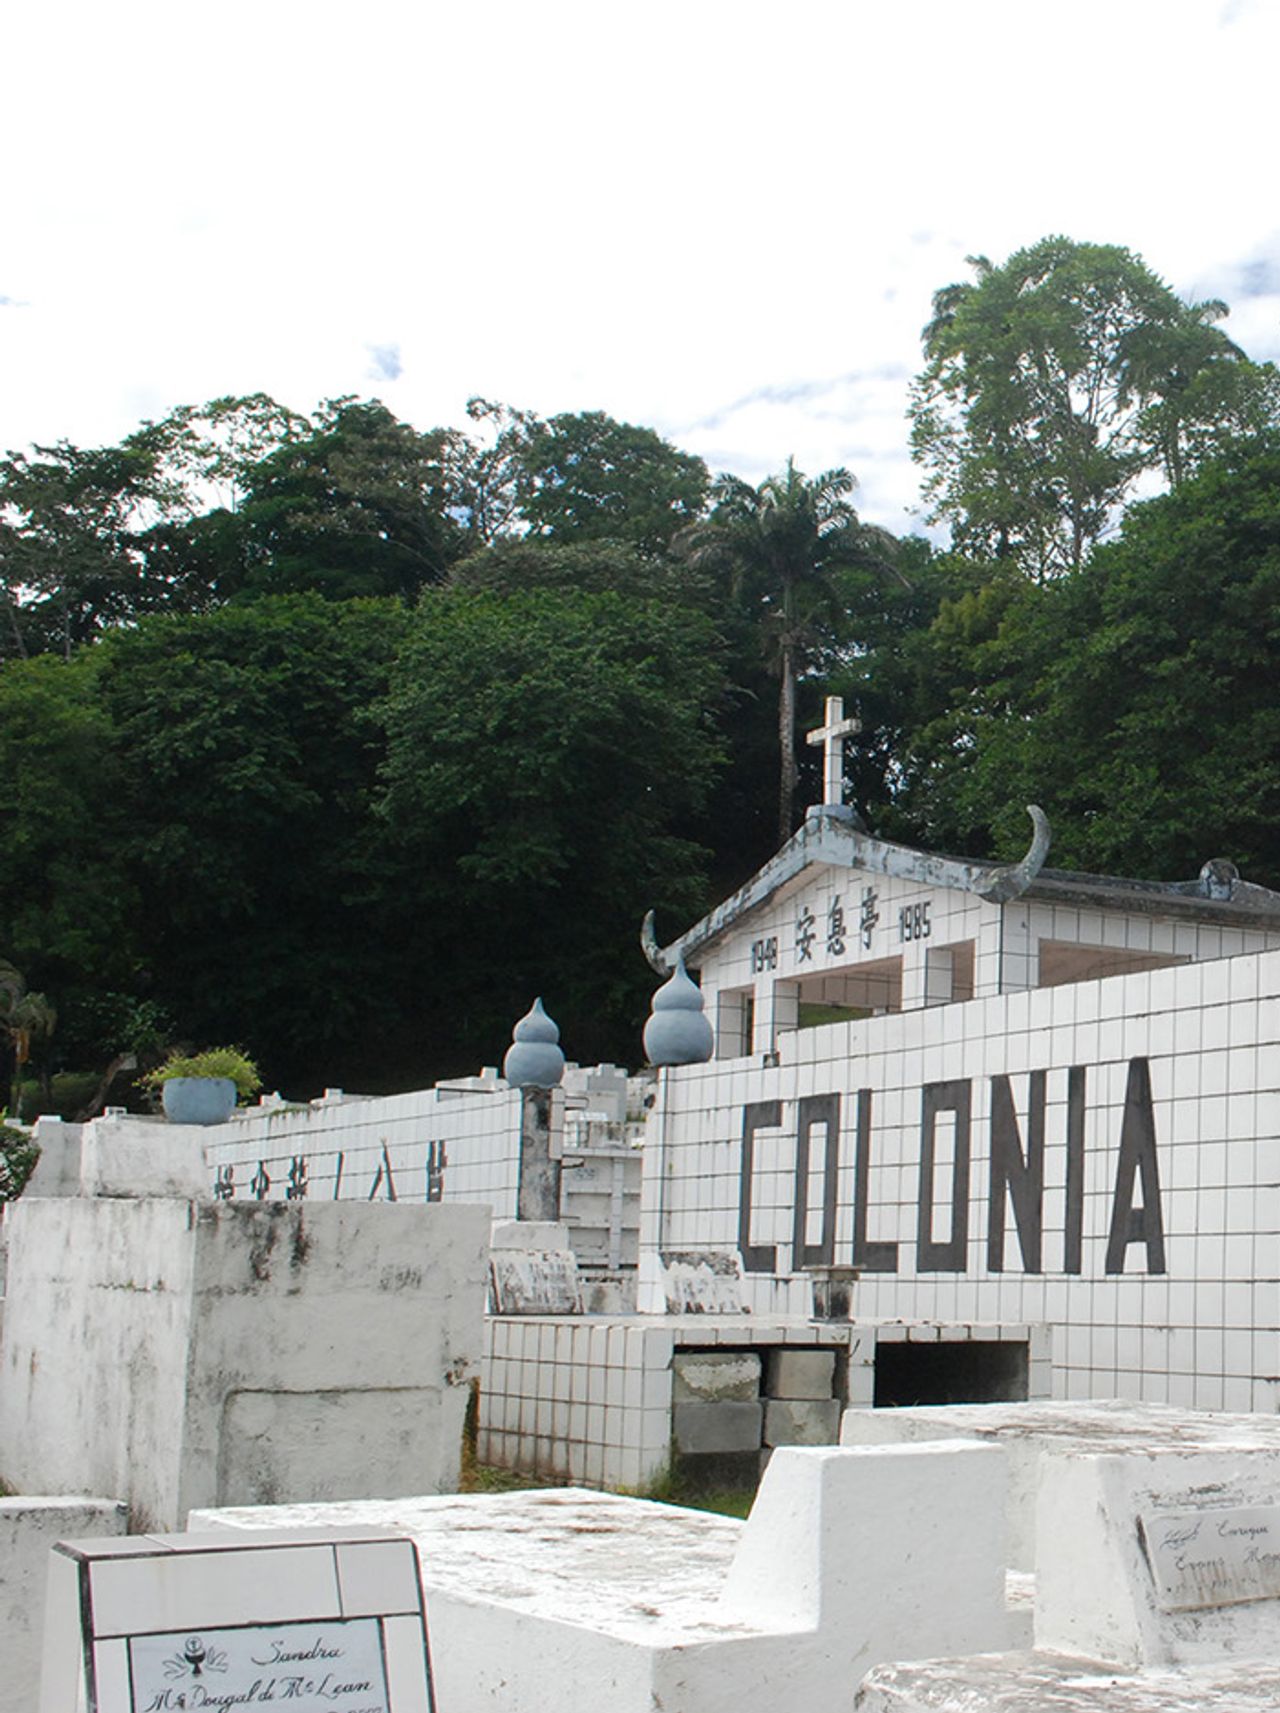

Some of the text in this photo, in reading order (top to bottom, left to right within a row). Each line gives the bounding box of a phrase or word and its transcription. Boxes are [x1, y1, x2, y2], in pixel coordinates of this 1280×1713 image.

[795, 886, 879, 963] 安息亭
[899, 901, 932, 943] 1985
[738, 1057, 1166, 1275] COLONIA
[251, 1637, 343, 1665] Sandra
